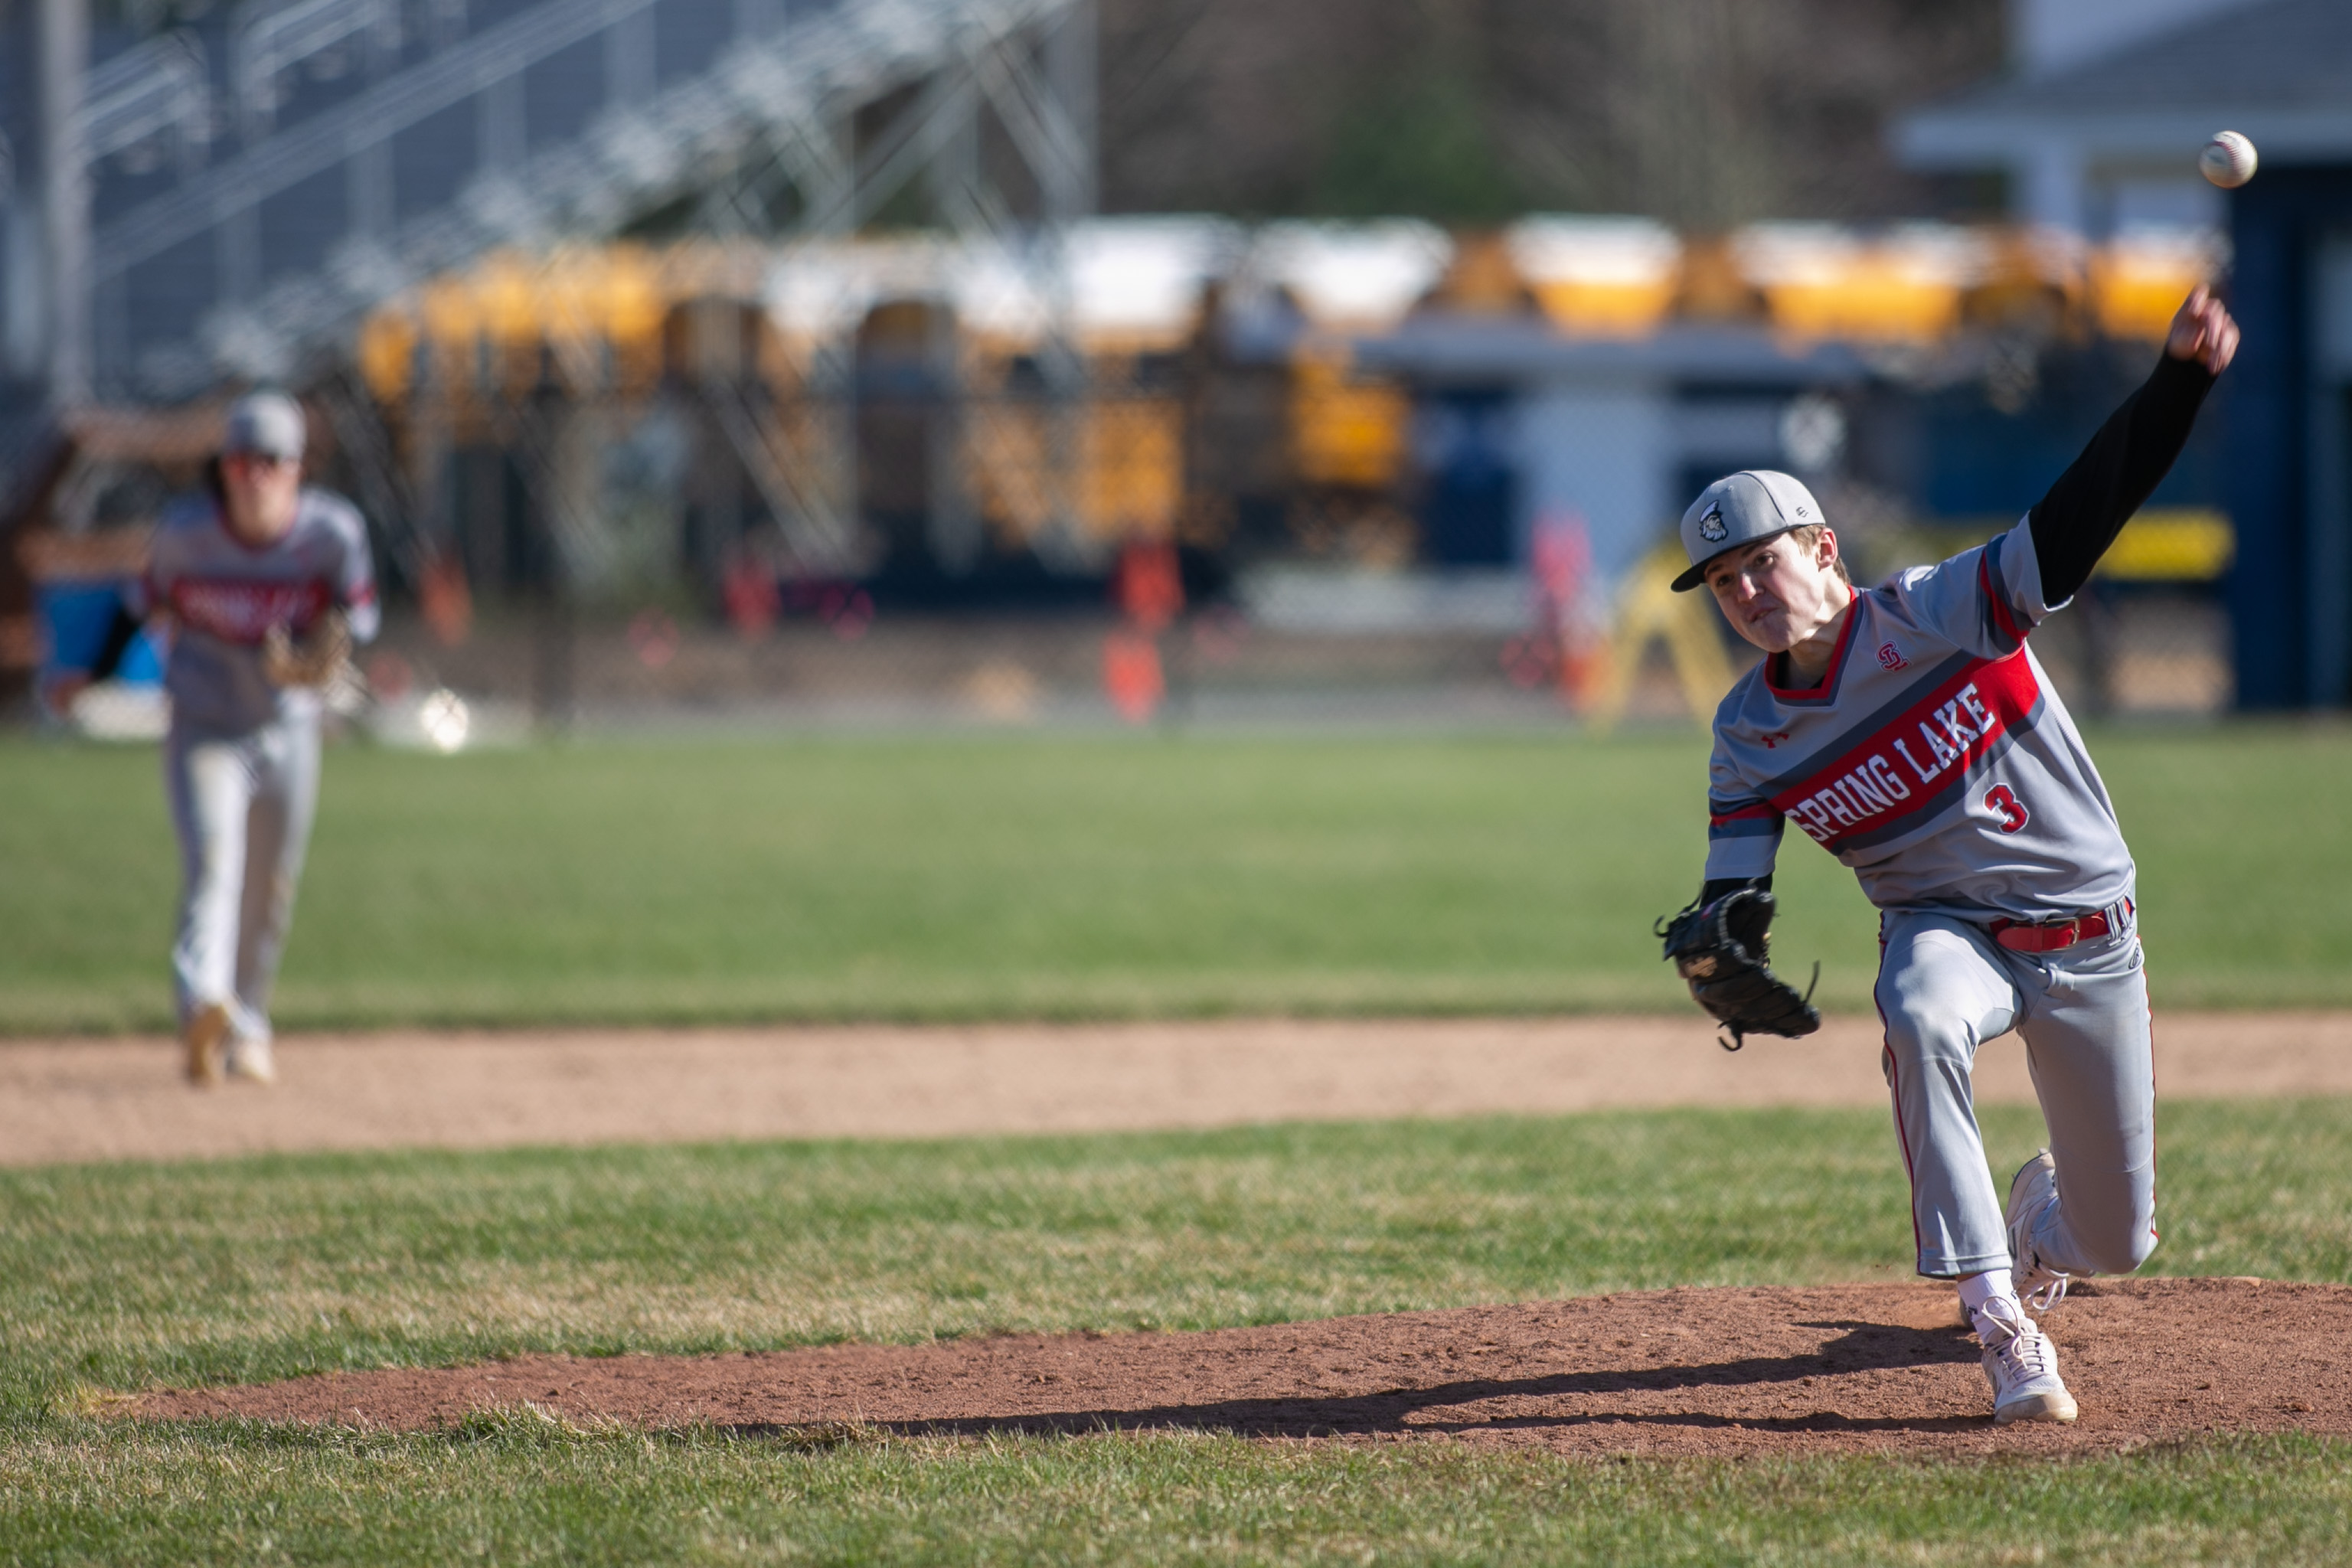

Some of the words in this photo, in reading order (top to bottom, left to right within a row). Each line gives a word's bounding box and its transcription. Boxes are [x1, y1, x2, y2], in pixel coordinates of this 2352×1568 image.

[1784, 754, 1911, 842] SPRING
[1893, 682, 1996, 784] LAKE
[1982, 782, 2030, 835] 3
